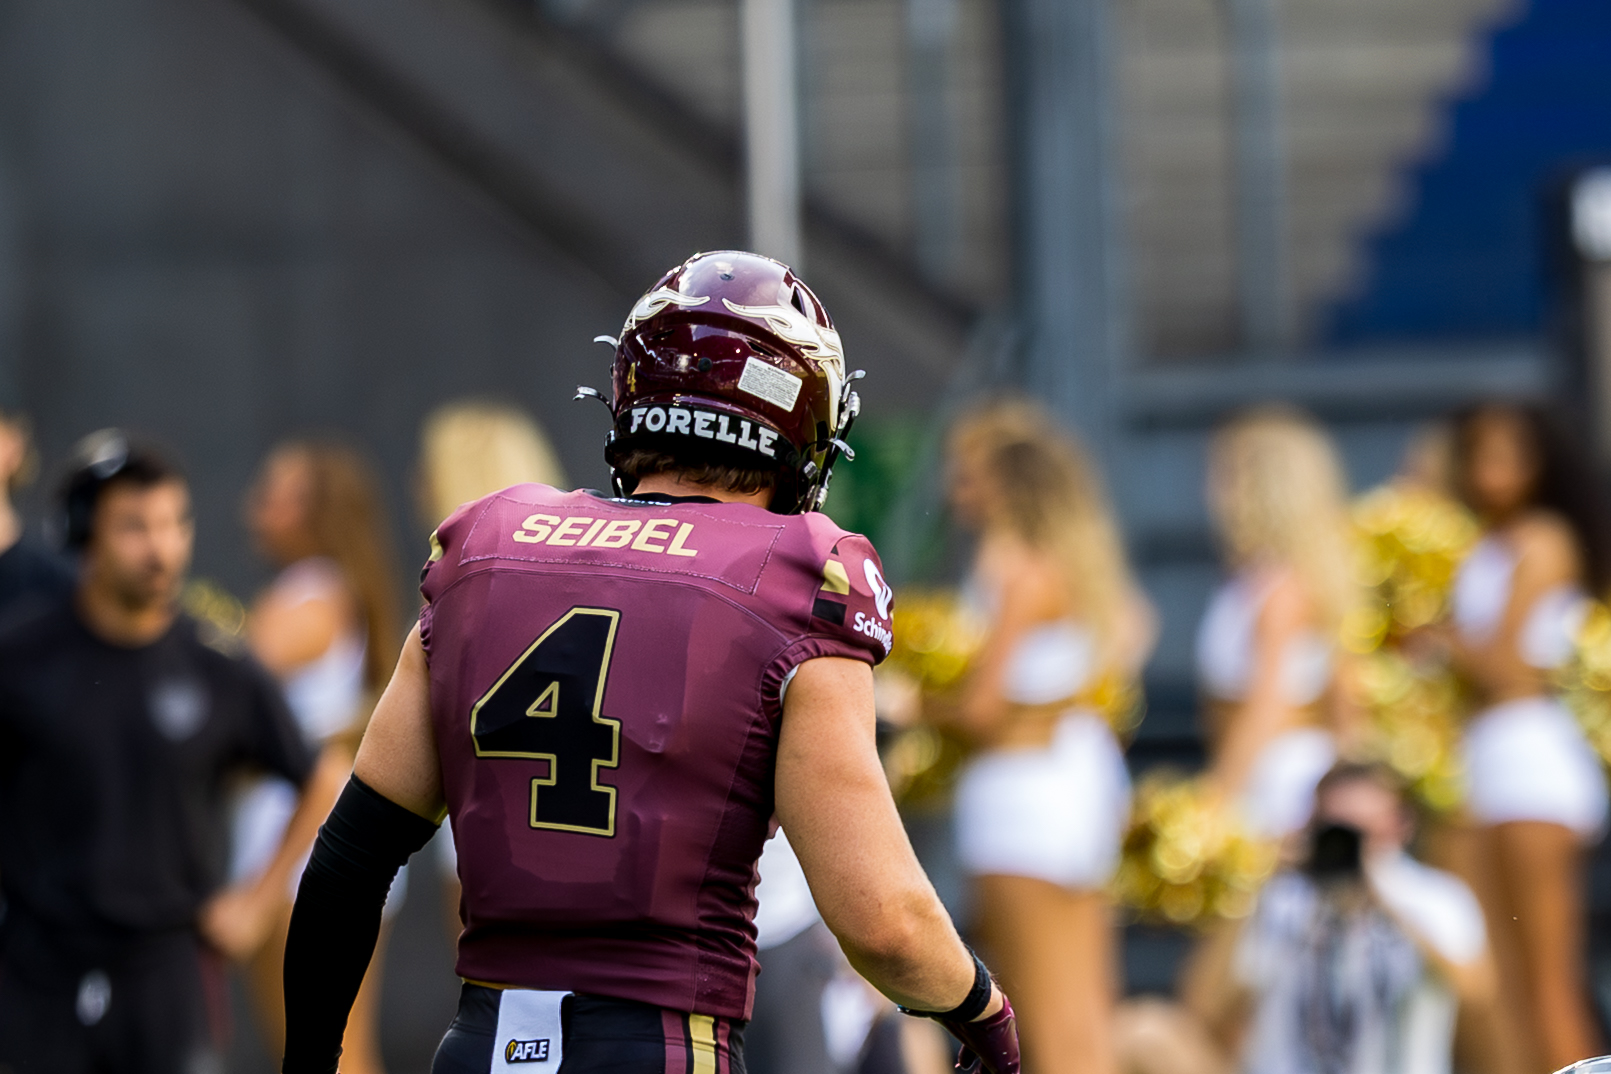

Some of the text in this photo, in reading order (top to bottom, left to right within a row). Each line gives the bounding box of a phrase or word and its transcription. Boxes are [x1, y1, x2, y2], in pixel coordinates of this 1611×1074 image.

[630, 407, 778, 458] FORELLE
[512, 514, 698, 557] SEIBEL
[470, 604, 622, 838] 4
[509, 1041, 548, 1061] AFLE
